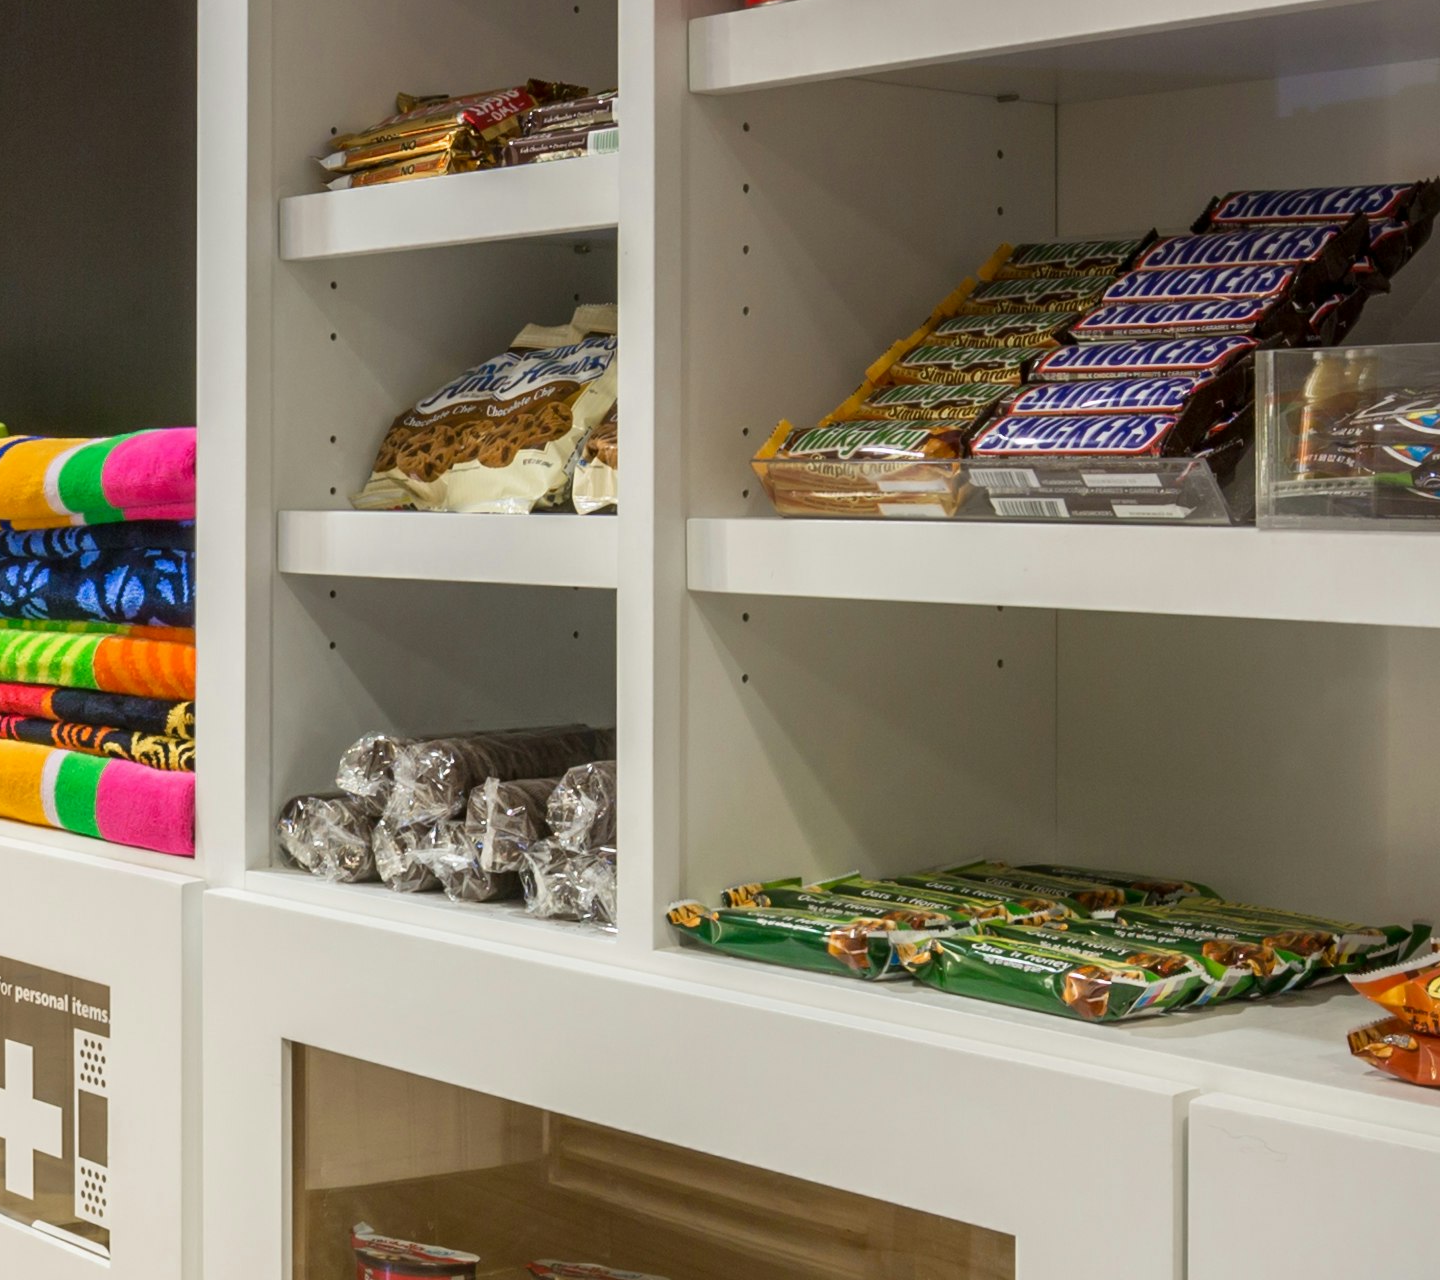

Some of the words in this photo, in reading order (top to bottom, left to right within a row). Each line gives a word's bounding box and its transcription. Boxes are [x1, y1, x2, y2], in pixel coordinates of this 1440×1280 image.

[1223, 185, 1401, 221] SNICKERS
[1145, 226, 1344, 267] SNICKERS
[1105, 264, 1294, 301] SNICKERS
[1076, 296, 1280, 330] SNICKERS
[1052, 334, 1252, 369] SNICKERS
[920, 368, 968, 385] Simply
[1016, 374, 1195, 414] SNICKERS
[487, 396, 532, 418] Chocolate
[534, 386, 556, 400] Chip
[976, 414, 1173, 453] SNICKERS
[1025, 952, 1074, 971] Honey
[15, 986, 68, 1012] personal
